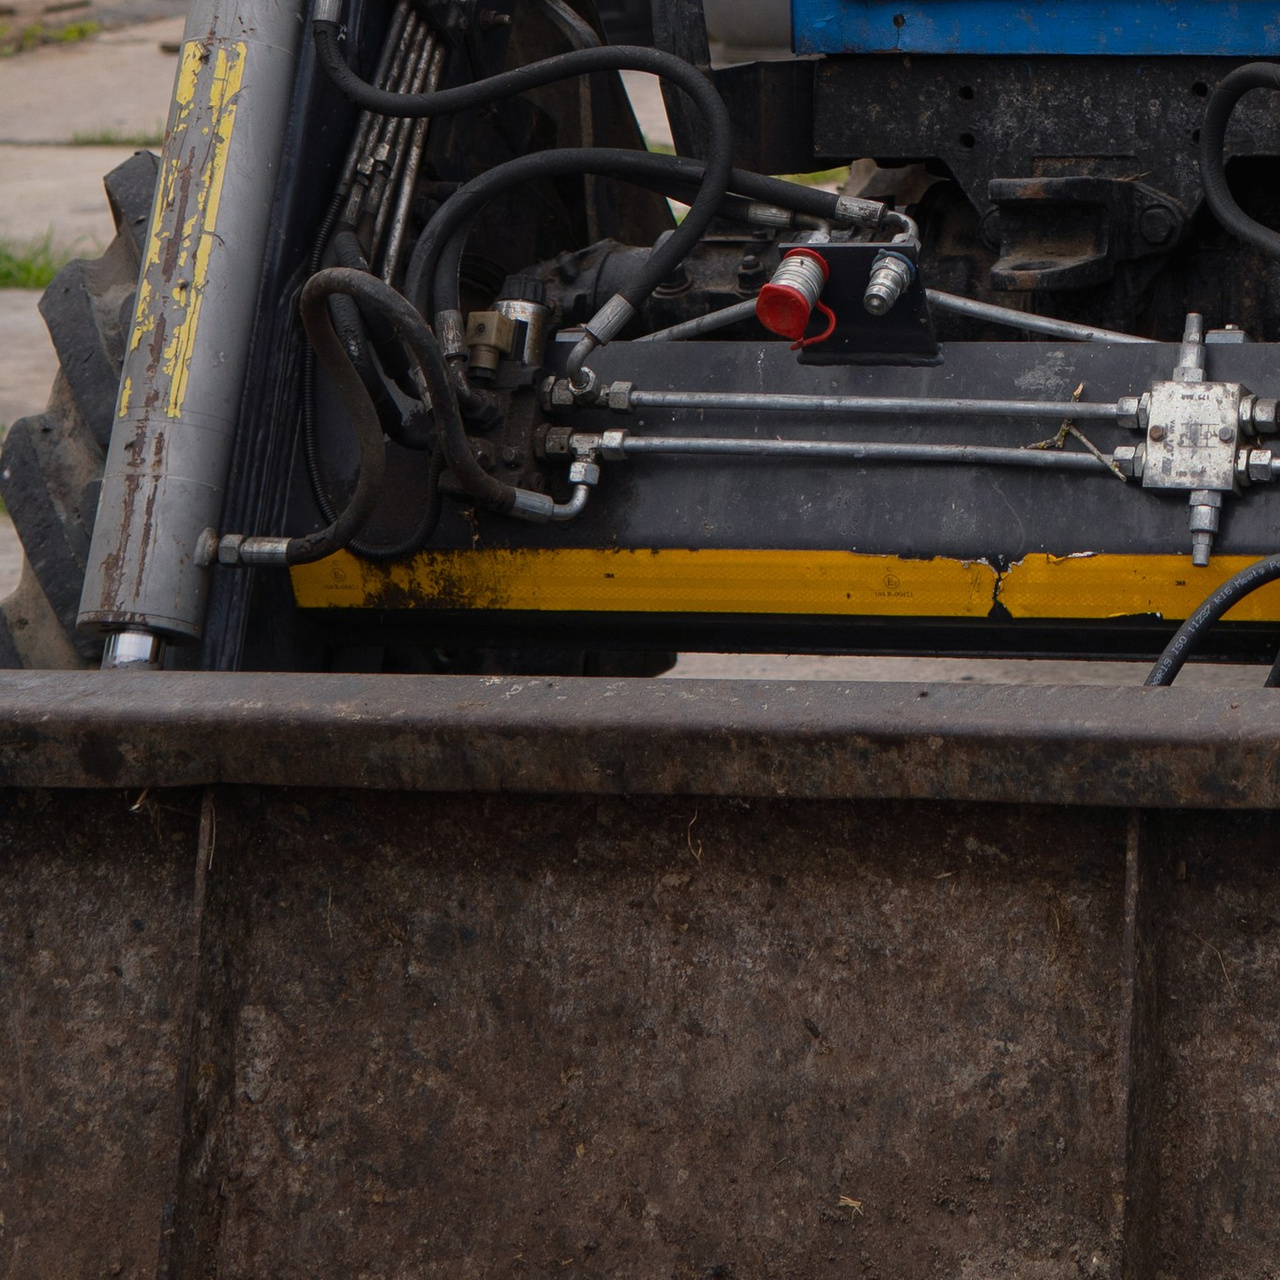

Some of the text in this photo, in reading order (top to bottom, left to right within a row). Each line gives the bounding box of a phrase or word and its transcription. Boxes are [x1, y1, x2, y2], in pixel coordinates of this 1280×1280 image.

[1171, 635, 1188, 656] ISO
[1187, 604, 1211, 633] 11237
[1234, 567, 1266, 589] Meets
